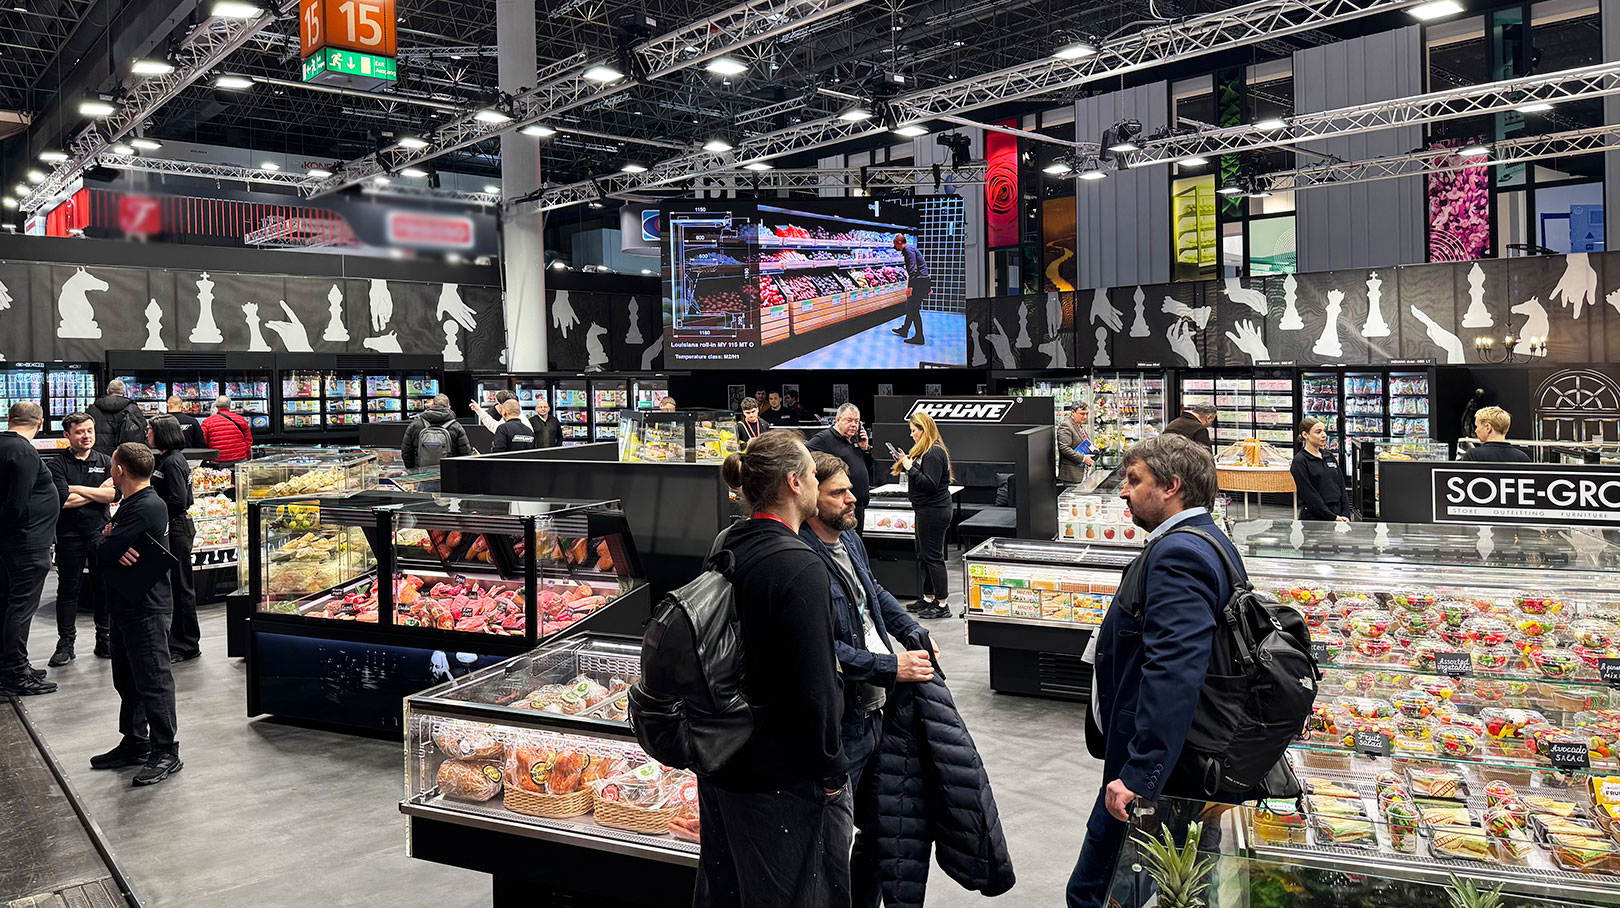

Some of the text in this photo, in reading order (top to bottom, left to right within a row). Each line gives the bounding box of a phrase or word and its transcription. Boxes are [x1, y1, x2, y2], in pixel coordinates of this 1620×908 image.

[304, 1, 319, 48] 15
[338, 1, 382, 46] 15
[1446, 476, 1620, 509] SOFE-GRO
[1452, 507, 1608, 519] STORE OUTFITTING FURNITURE
[1437, 657, 1470, 665] Assorted
[1437, 664, 1472, 673] vegetables
[1357, 731, 1381, 741] Fruit
[1358, 740, 1383, 748] salad
[1550, 744, 1587, 754] Avocado
